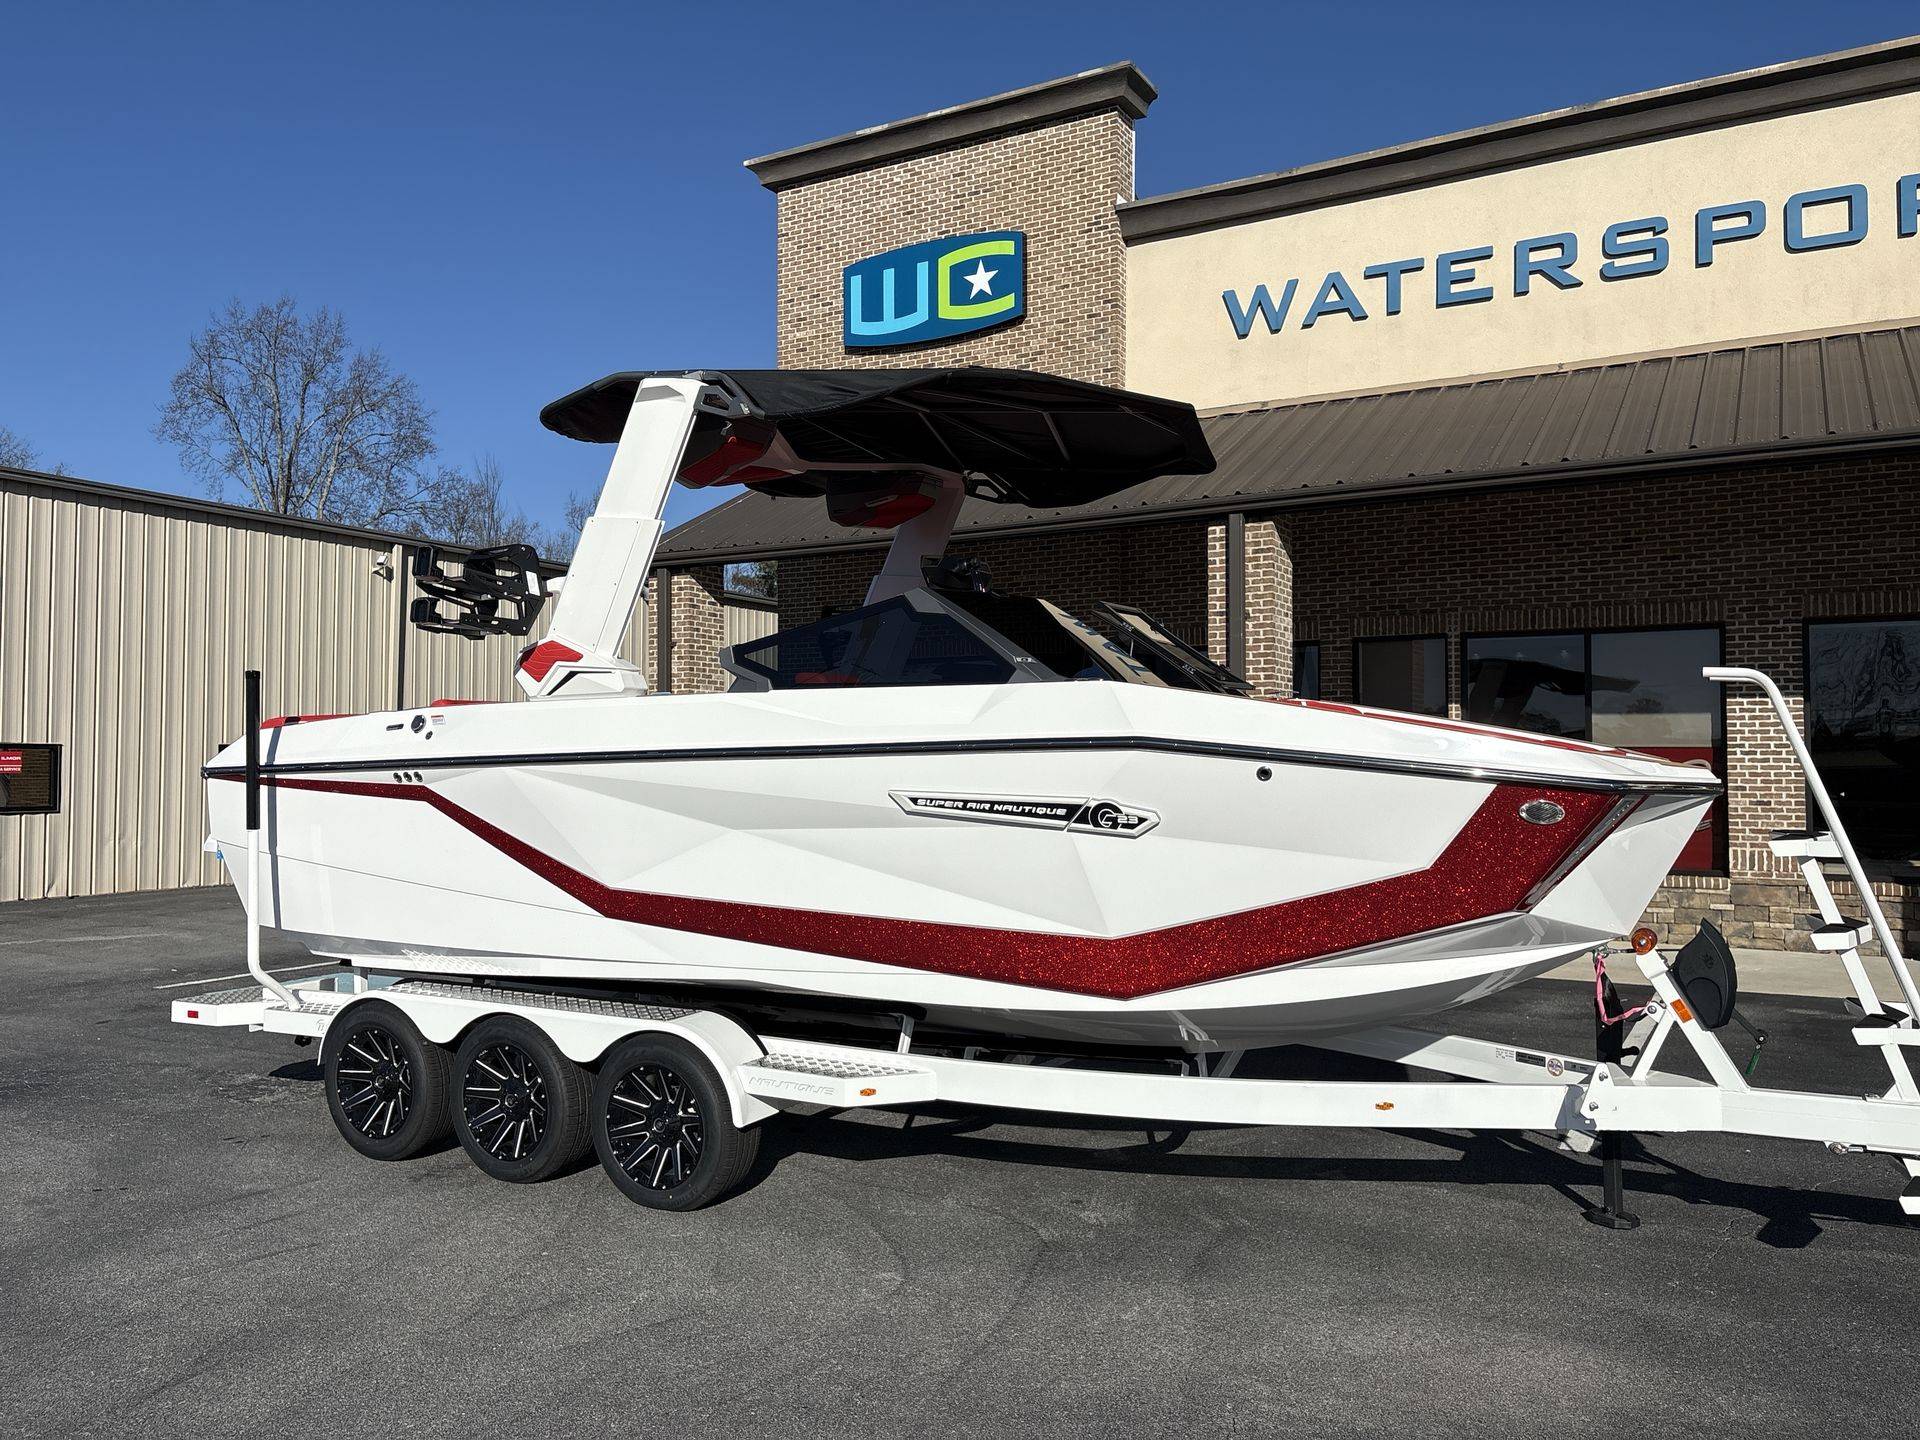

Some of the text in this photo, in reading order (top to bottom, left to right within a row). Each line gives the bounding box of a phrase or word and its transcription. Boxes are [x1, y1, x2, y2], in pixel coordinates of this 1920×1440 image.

[850, 240, 1016, 336] WC
[917, 799, 964, 808] SUPER
[967, 802, 991, 811] AIR
[993, 803, 1067, 815] NAUTIQUE
[750, 1076, 835, 1096] NAUTIQUE
